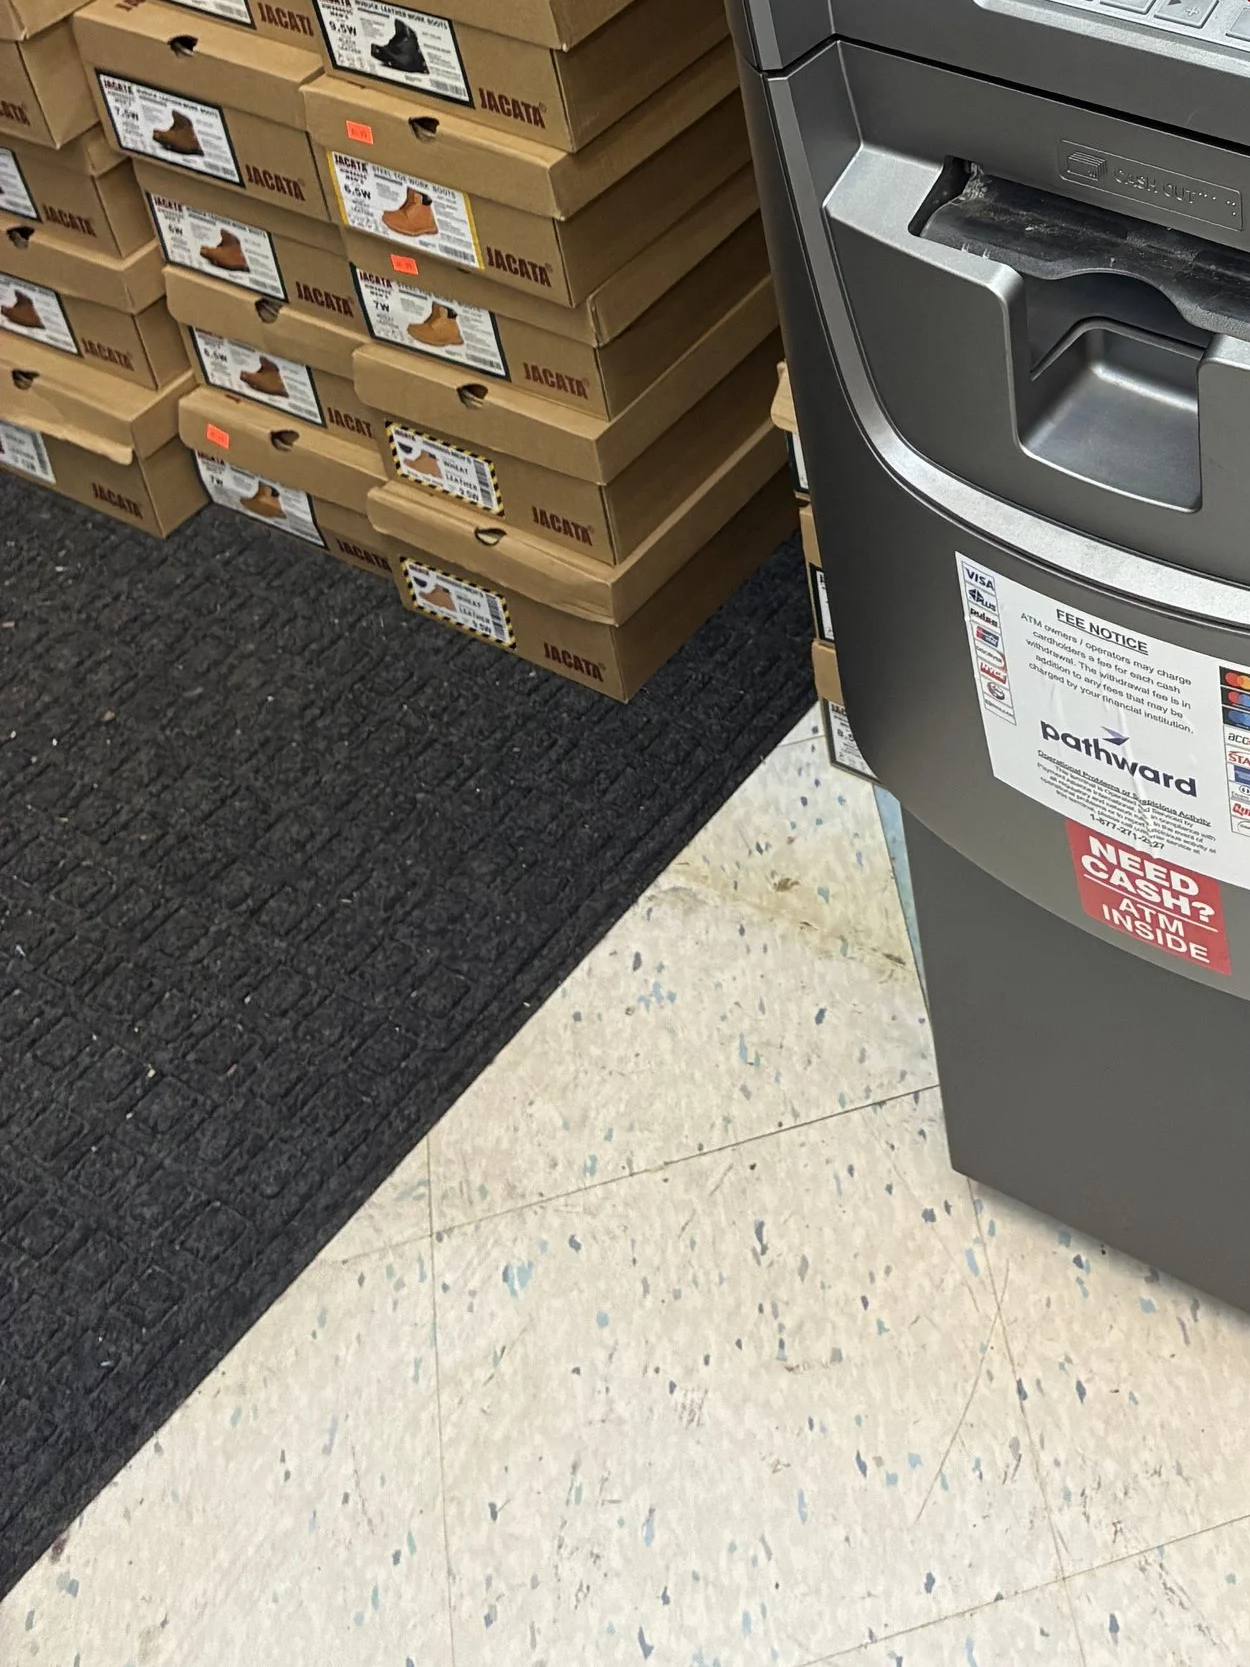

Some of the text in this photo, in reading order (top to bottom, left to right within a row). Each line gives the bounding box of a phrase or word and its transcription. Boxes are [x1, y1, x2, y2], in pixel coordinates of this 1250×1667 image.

[478, 87, 546, 129] JACATA
[246, 163, 305, 201] JACATA
[335, 153, 368, 173] JACATA
[1114, 168, 1194, 204] CASH OUT
[43, 204, 97, 237] JACATA
[486, 246, 553, 288] JACATA
[296, 281, 354, 318] JACATA
[82, 337, 135, 372] JACATA
[523, 362, 589, 400] JACATA
[327, 406, 373, 438] JACAT
[92, 482, 144, 520] JACATA
[532, 505, 593, 546] JACATA
[965, 567, 995, 592] VISA
[1021, 612, 1192, 686] ATM owners operators may charge
[1056, 608, 1149, 653] FEE NOTICE
[543, 641, 605, 682] JACATA
[1033, 631, 1086, 659] cardholders
[1114, 664, 1128, 675] for
[1130, 670, 1154, 685] each
[1156, 679, 1181, 694] cash
[1028, 662, 1064, 684] charged
[1067, 678, 1078, 692] by
[1080, 684, 1101, 699] your
[1102, 693, 1142, 715] financial
[1144, 708, 1194, 734] institution.
[1035, 653, 1070, 675] addition
[1073, 670, 1082, 680] to
[1084, 675, 1101, 690] any
[1126, 689, 1145, 705] that
[1147, 701, 1168, 714] may
[1170, 708, 1183, 719] be
[1079, 660, 1097, 675] The
[1100, 671, 1150, 695] withdrawal
[1182, 699, 1191, 710] in
[1040, 720, 1198, 798] pathward
[1088, 835, 1200, 897] NEED
[1081, 855, 1216, 923] CASH?
[1101, 904, 1211, 964] INSIDE
[1118, 897, 1185, 937] ATM
